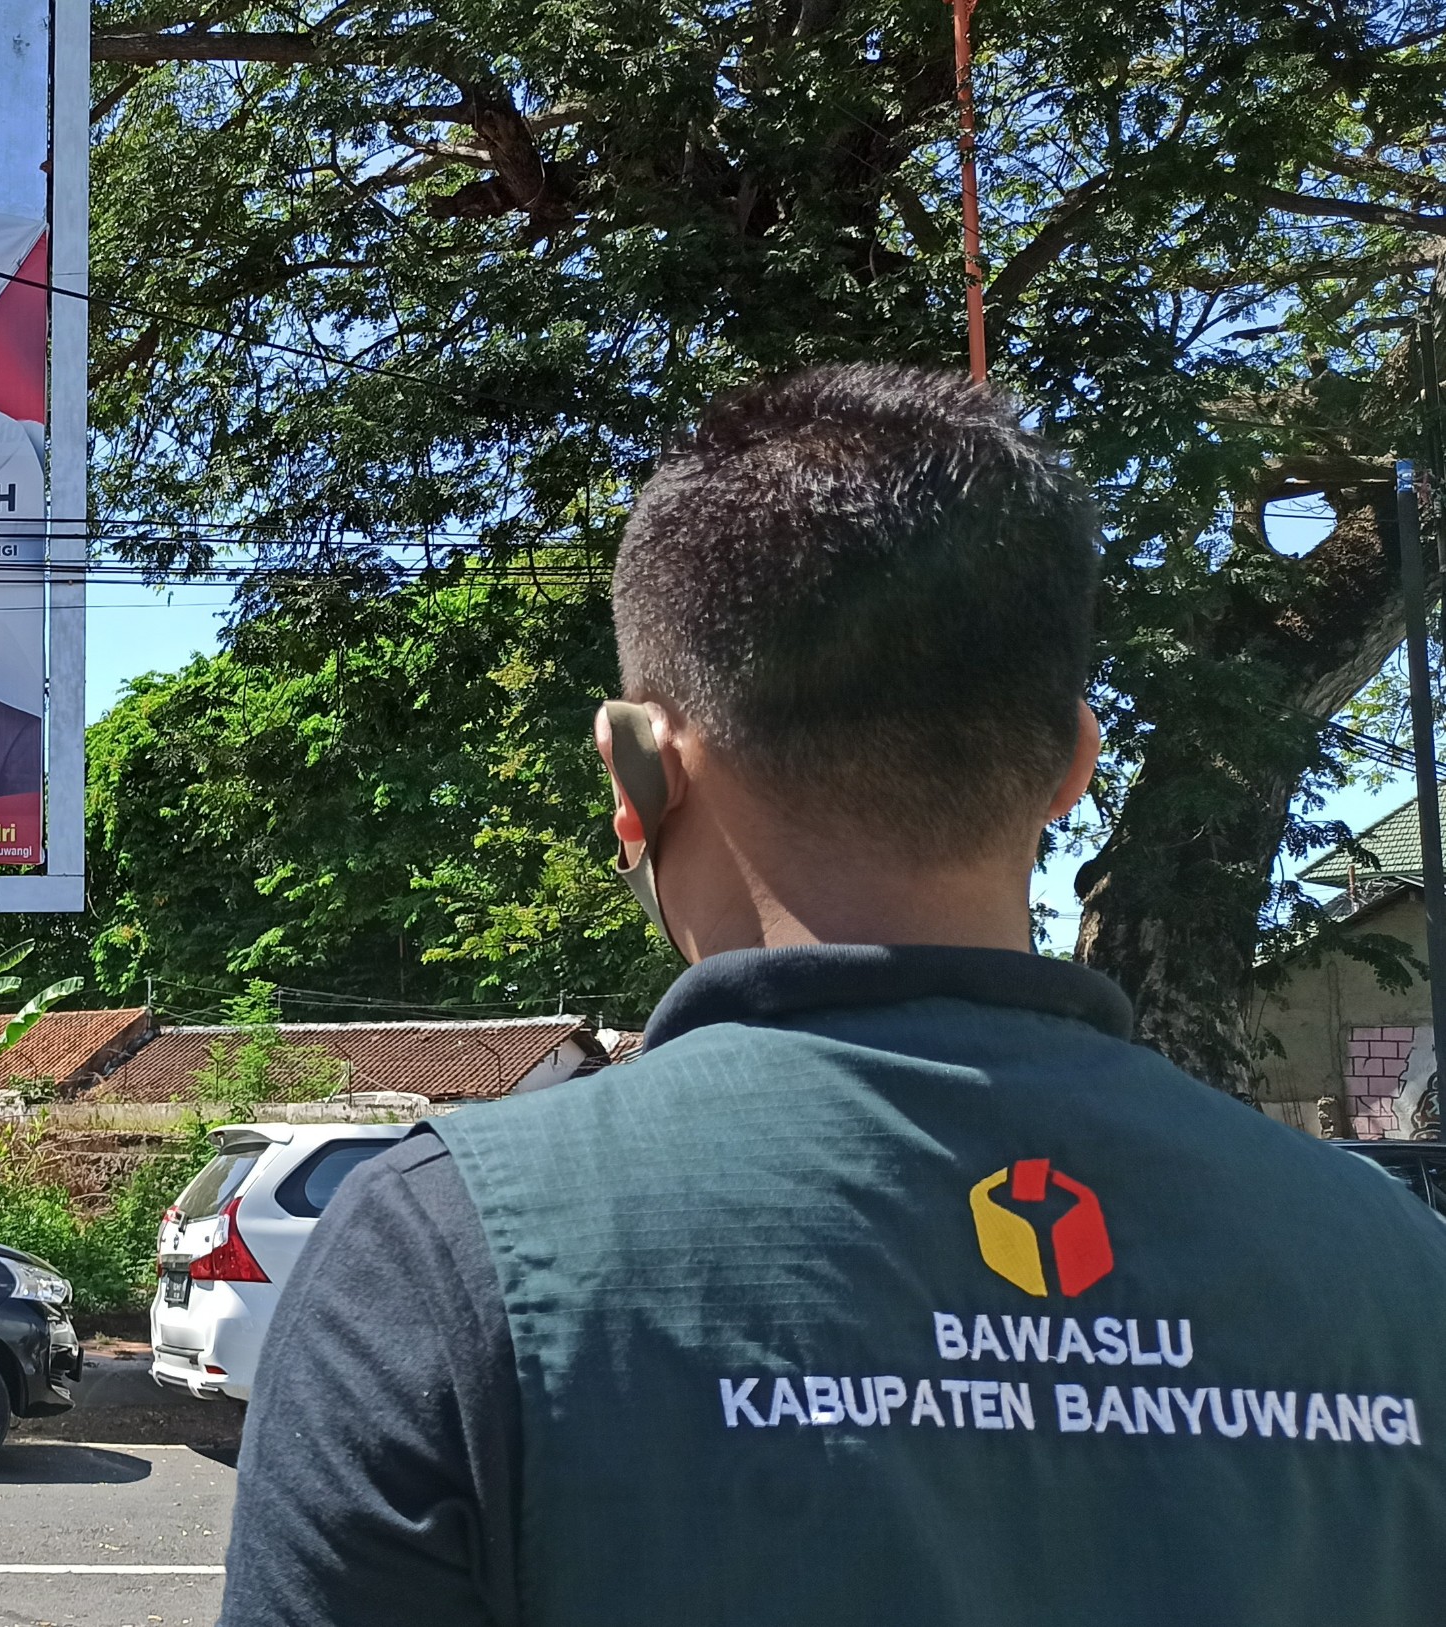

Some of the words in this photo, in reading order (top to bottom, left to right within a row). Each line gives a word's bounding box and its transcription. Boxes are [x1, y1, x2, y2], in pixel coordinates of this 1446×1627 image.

[934, 1311, 1195, 1368] BAWASLU
[718, 1376, 1036, 1431] KABUPATEN
[1055, 1383, 1422, 1447] BANYUWANGI
